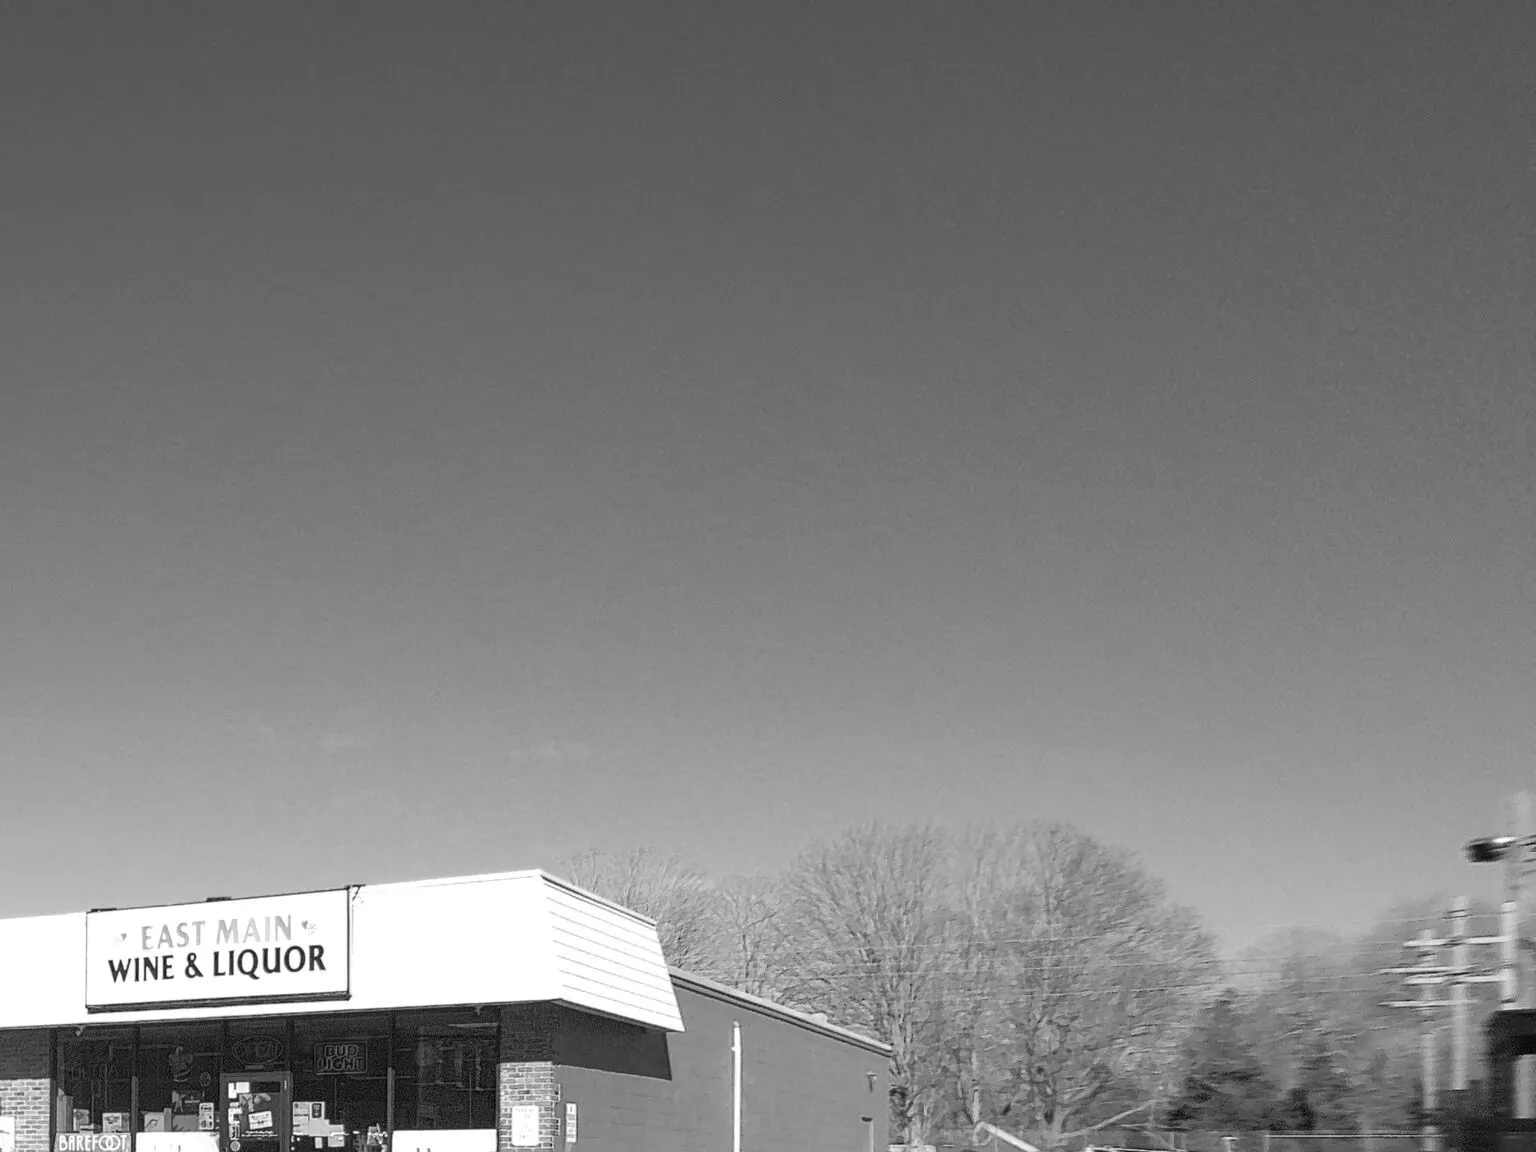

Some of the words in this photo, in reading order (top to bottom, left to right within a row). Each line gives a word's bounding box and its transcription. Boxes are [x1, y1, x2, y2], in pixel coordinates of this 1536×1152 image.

[141, 920, 206, 950] EAST
[216, 914, 292, 945] MAIN
[108, 954, 175, 983] WINE
[184, 952, 204, 979] &
[213, 944, 326, 980] LIQUOR
[324, 1044, 360, 1058] BUD
[317, 1056, 363, 1072] LIGHT
[59, 1135, 127, 1151] BAREFOOT
